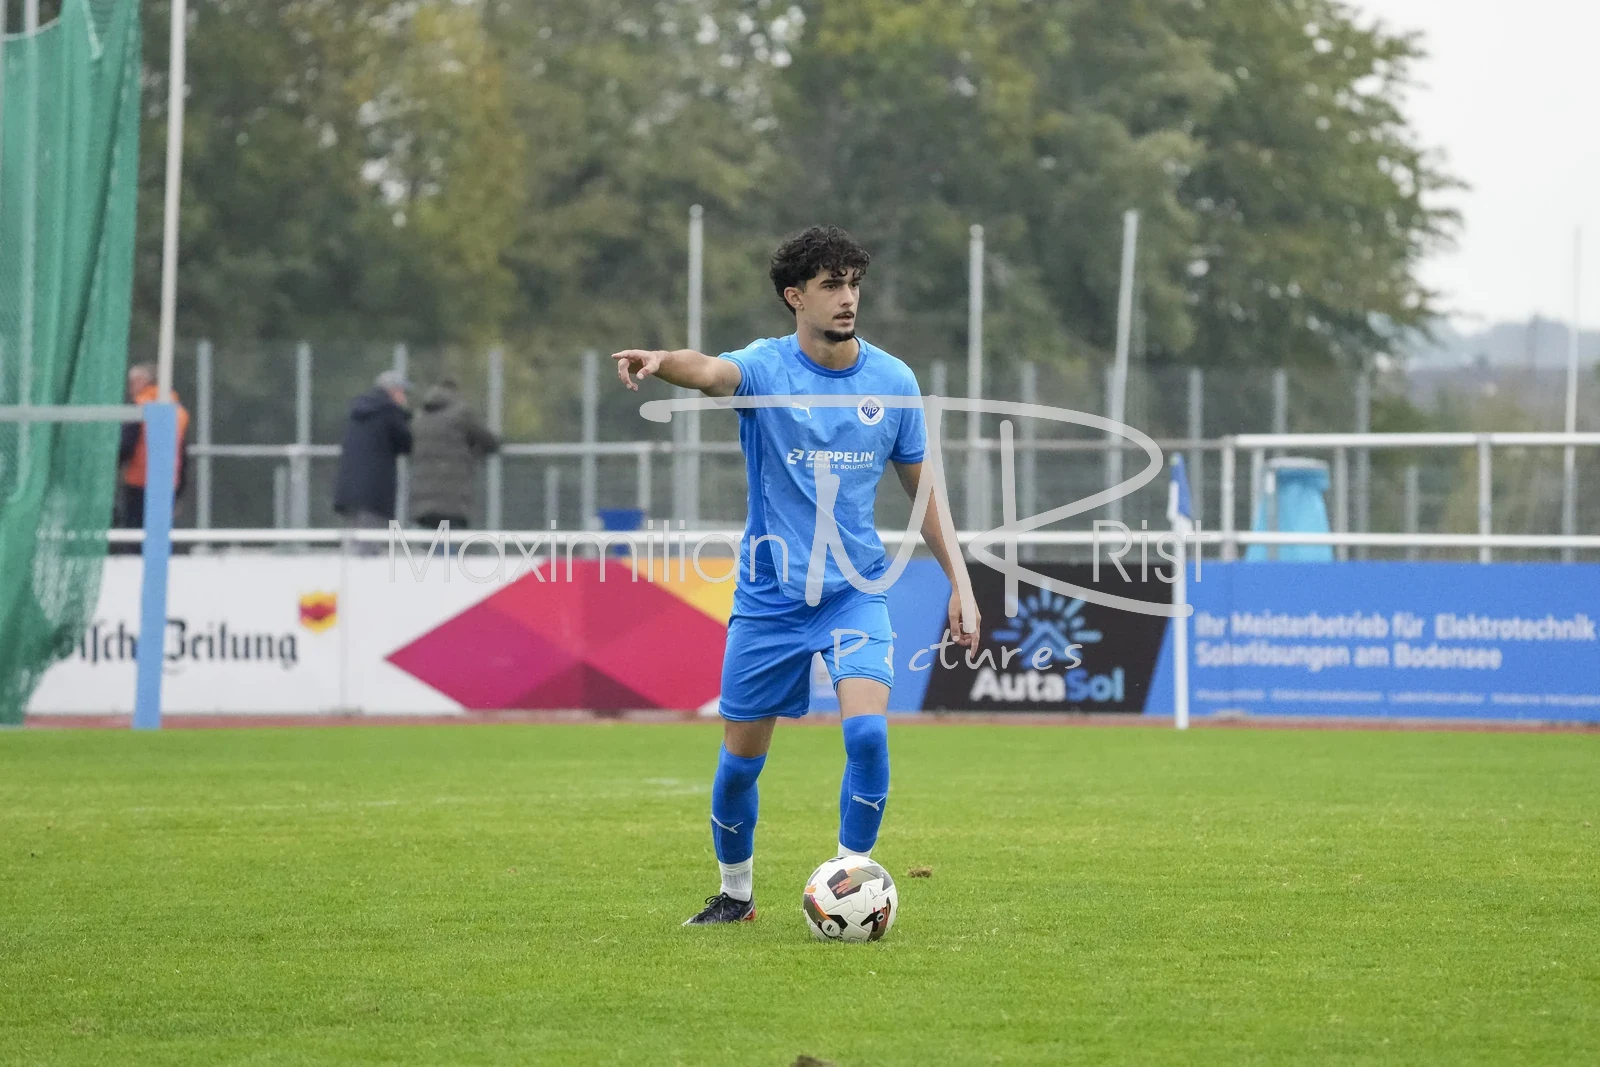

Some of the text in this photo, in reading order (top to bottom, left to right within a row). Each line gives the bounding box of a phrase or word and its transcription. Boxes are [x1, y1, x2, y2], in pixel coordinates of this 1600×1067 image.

[806, 450, 875, 463] ZEPPELIN
[840, 462, 873, 470] SOLUTIONS
[1195, 609, 1597, 641] Ihr Meisterbetrieb für Elektrotechnik
[163, 617, 298, 670] Zeitung
[1195, 640, 1502, 672] Solarlösungen am Bodensee
[970, 667, 1125, 702] AutaSol
